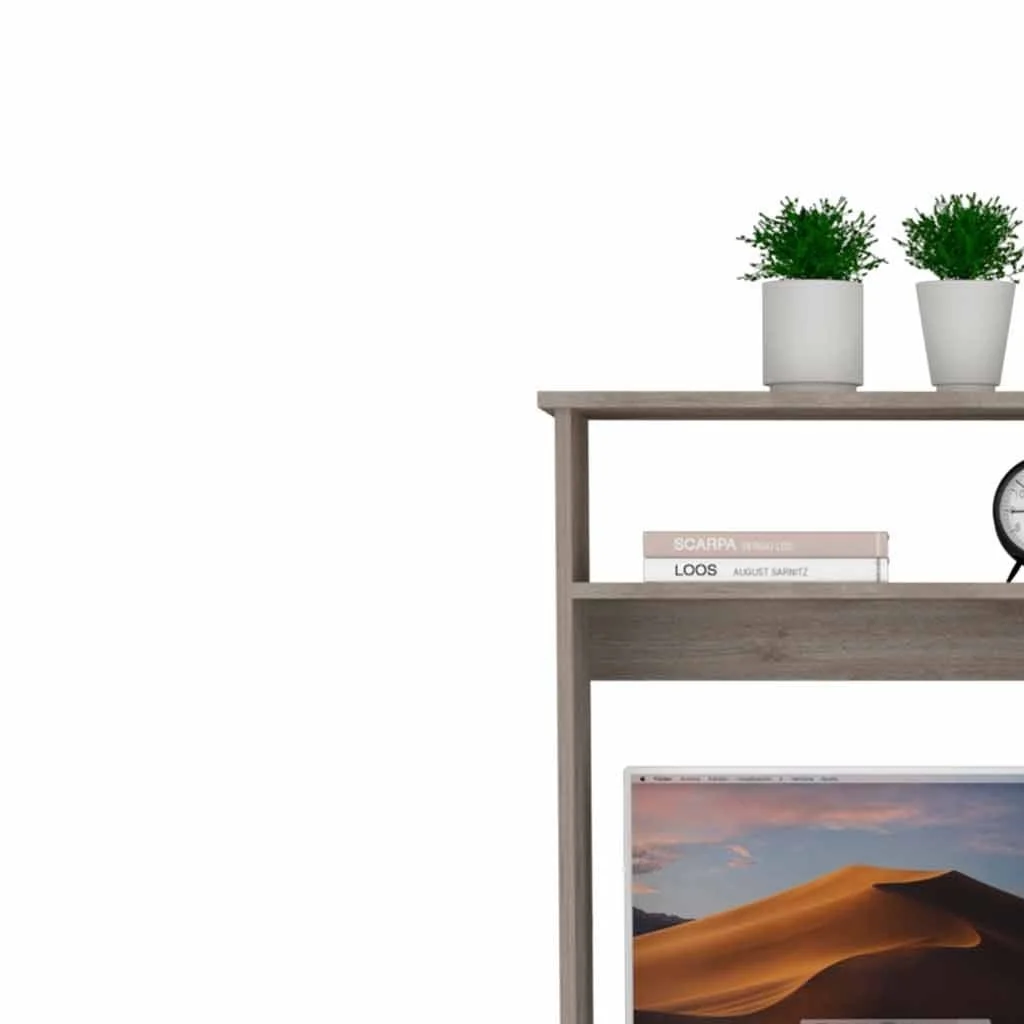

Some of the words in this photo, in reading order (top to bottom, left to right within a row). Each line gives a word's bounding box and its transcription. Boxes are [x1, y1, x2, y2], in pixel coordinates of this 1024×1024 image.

[674, 537, 737, 551] SCARPA
[675, 563, 718, 577] LOOS
[732, 567, 769, 577] AUGUST
